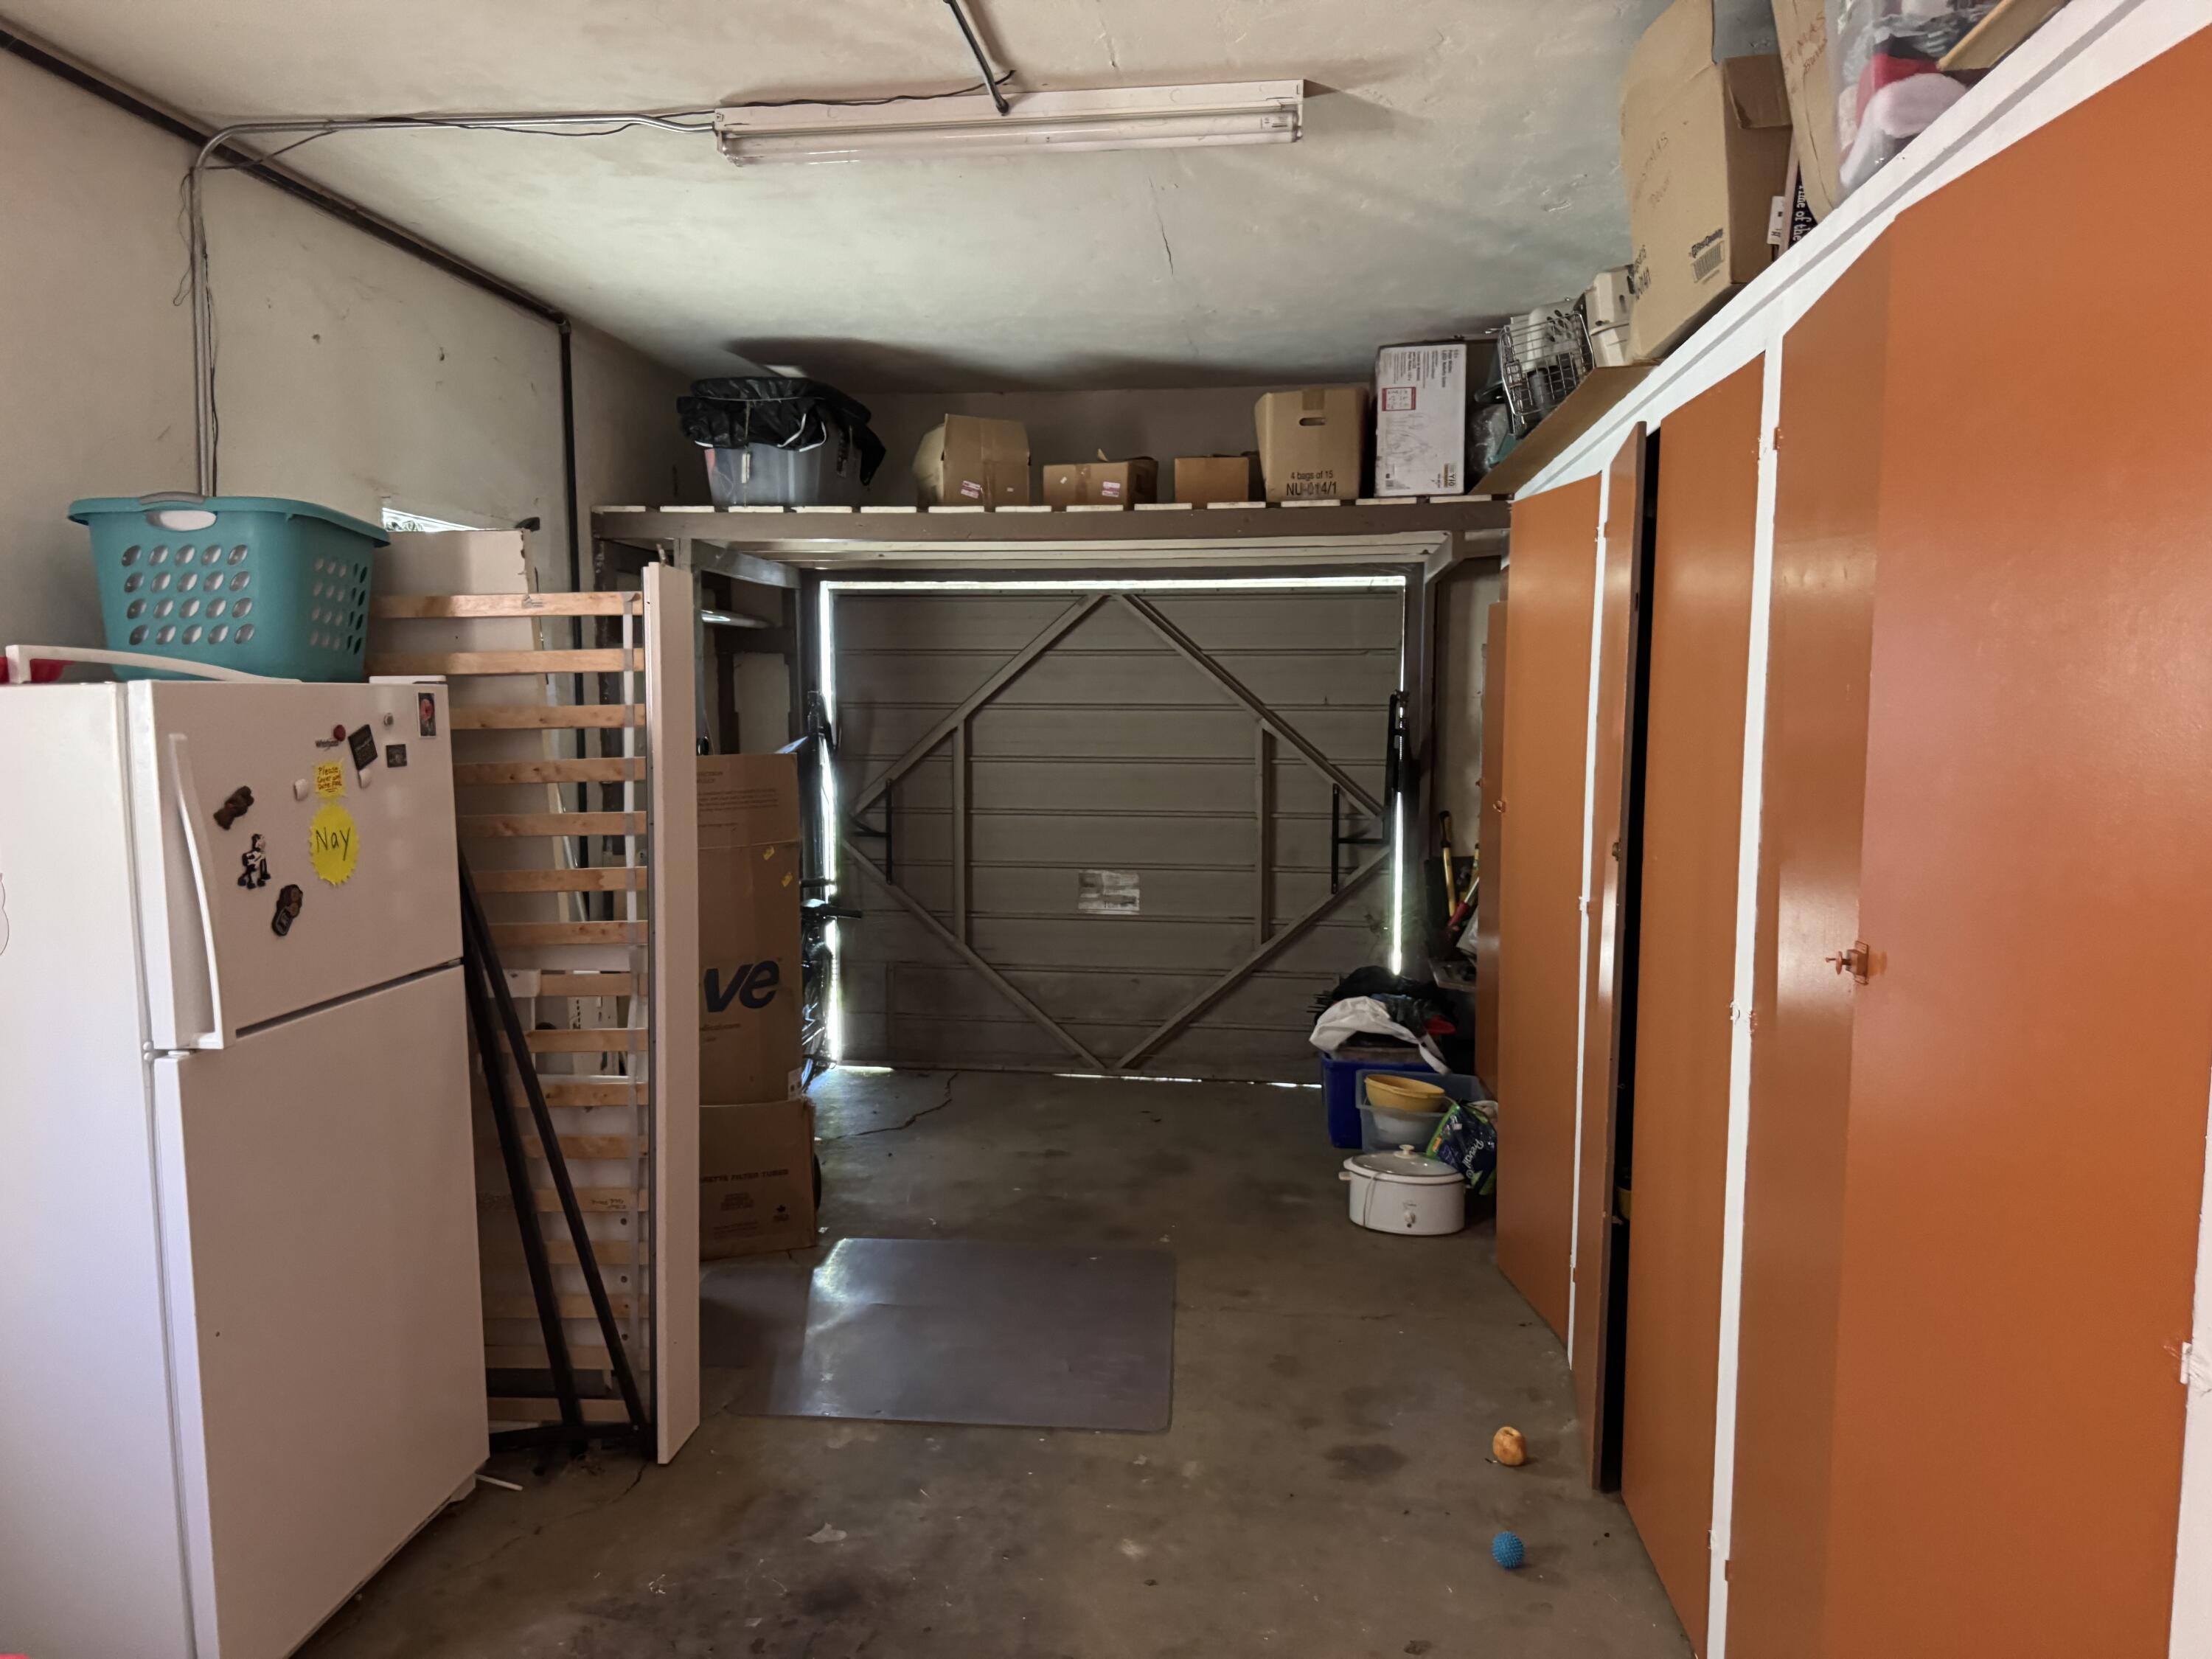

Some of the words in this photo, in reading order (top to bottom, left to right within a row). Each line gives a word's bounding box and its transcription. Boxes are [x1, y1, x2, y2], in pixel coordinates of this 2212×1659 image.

[1795, 211, 1812, 223] of
[1792, 223, 1812, 241] the
[1297, 472, 1314, 481] bags
[1316, 470, 1323, 479] of
[1325, 470, 1333, 479] 15
[316, 827, 351, 861] Nay
[703, 960, 779, 1013] ve
[1462, 1138, 1484, 1169] Prevail
